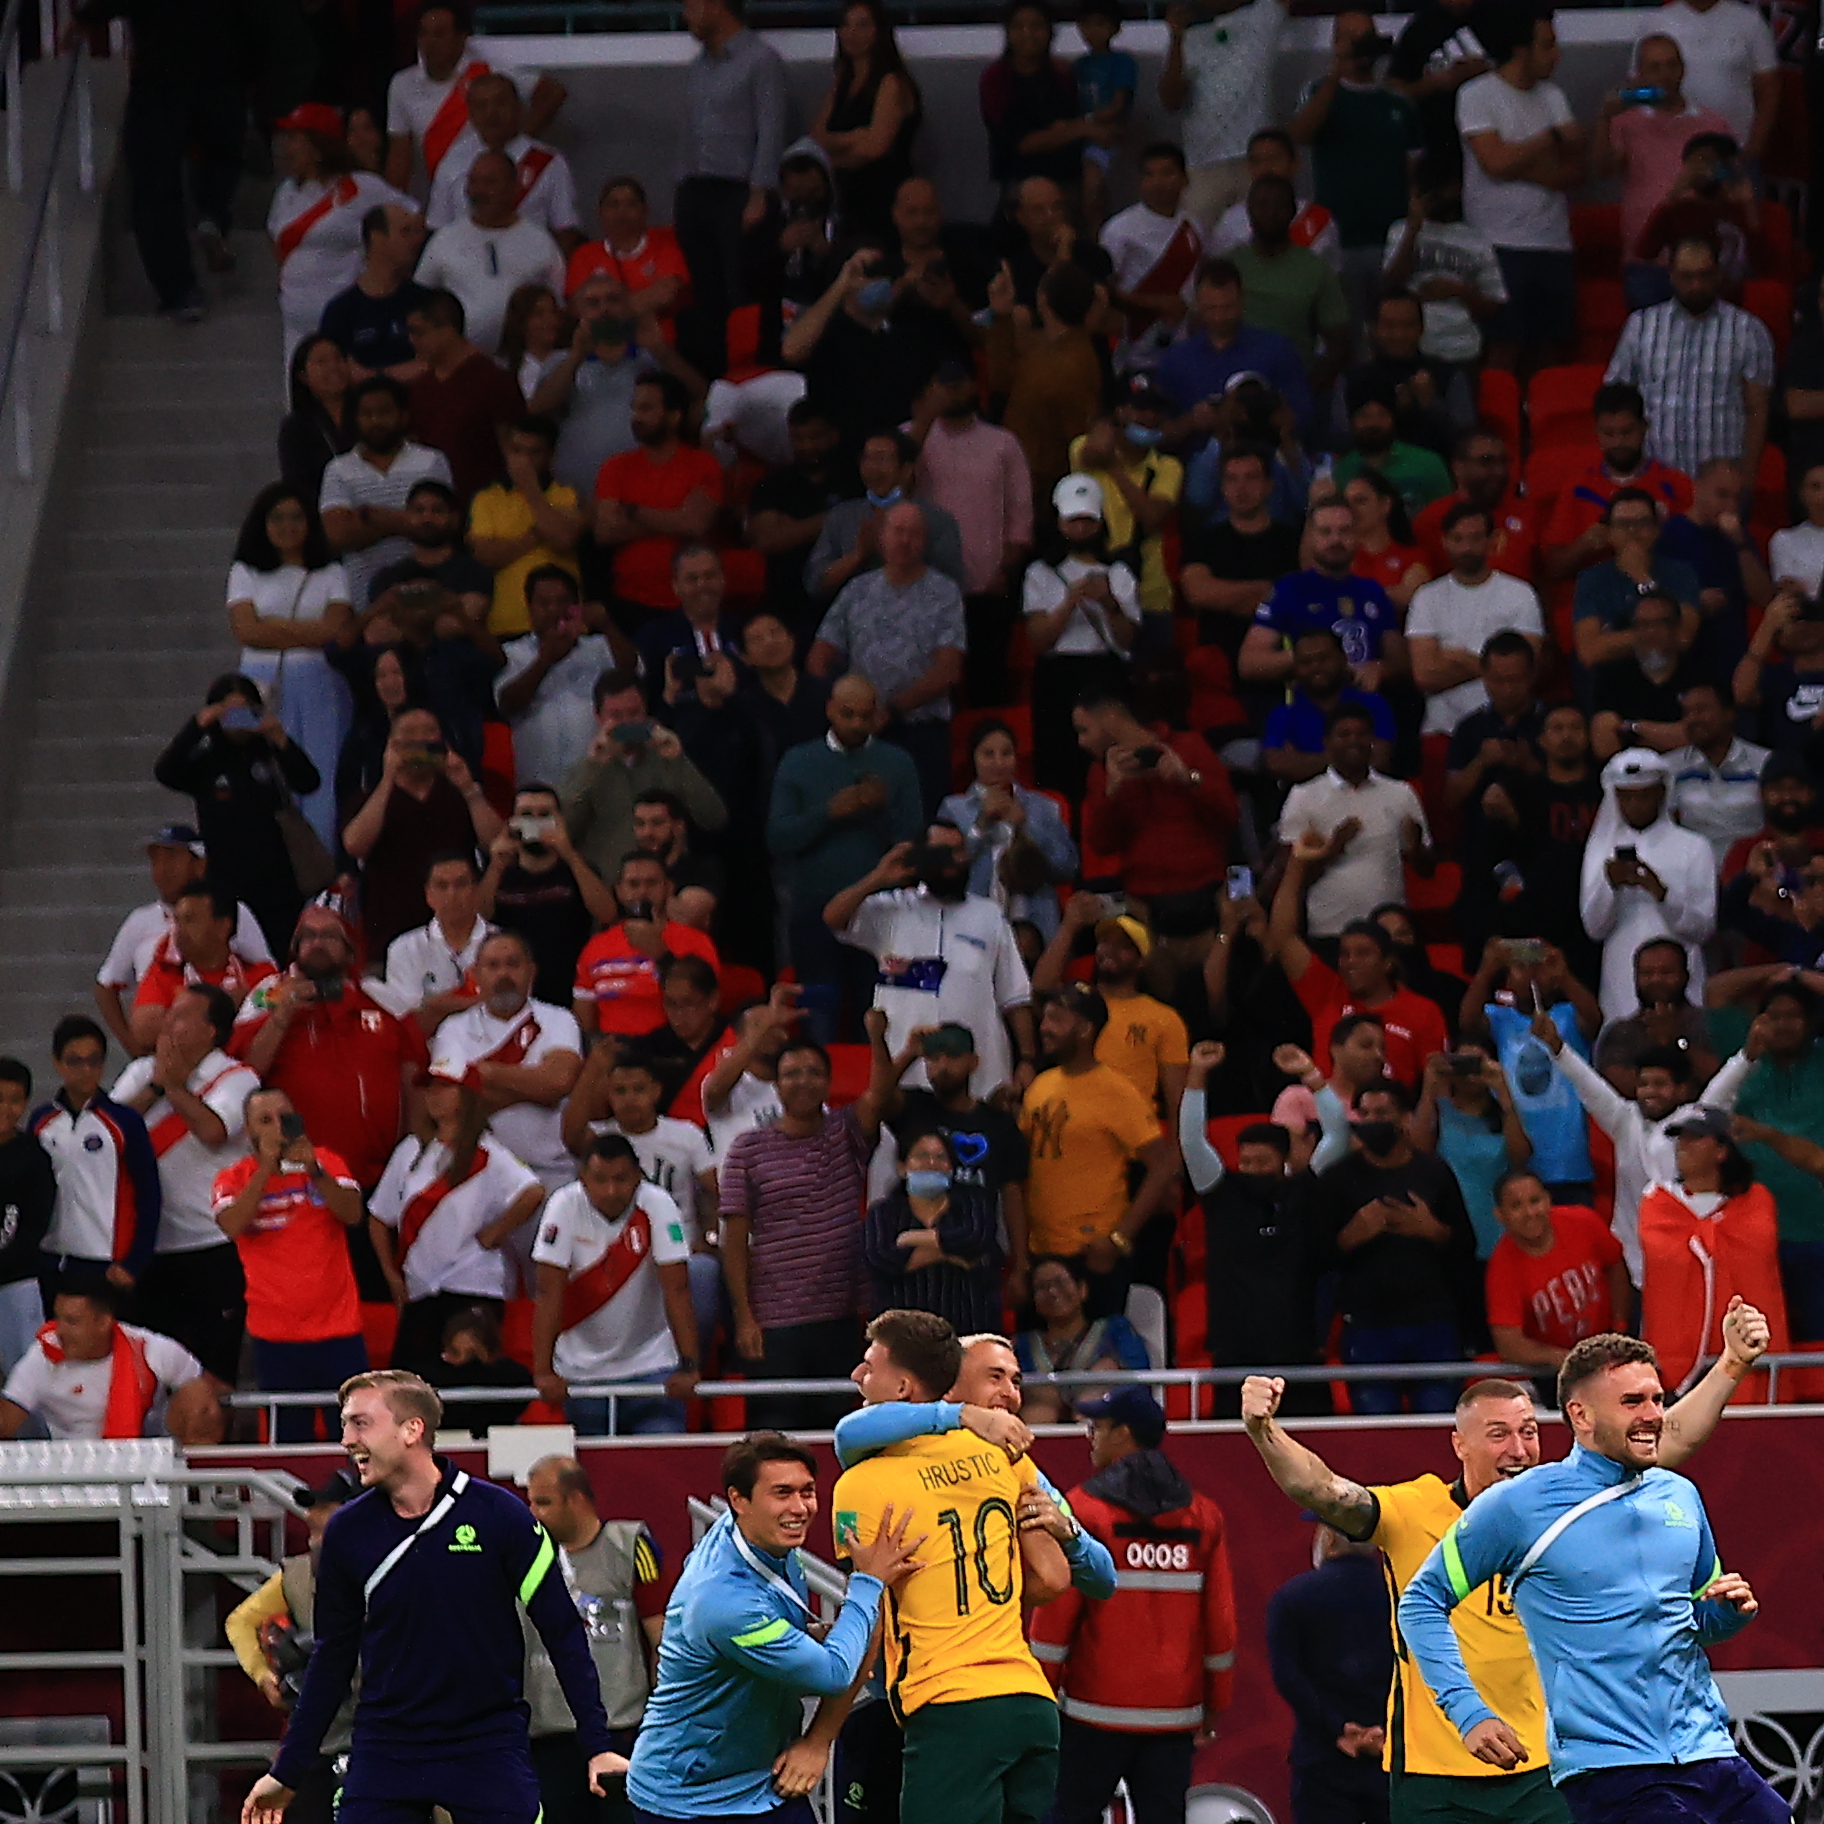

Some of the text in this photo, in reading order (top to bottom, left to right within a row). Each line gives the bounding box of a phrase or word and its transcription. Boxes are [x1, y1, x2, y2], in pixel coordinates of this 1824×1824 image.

[917, 1452, 1000, 1491] HRUSTIC
[937, 1497, 1015, 1617] 10
[1126, 1541, 1190, 1571] 0008
